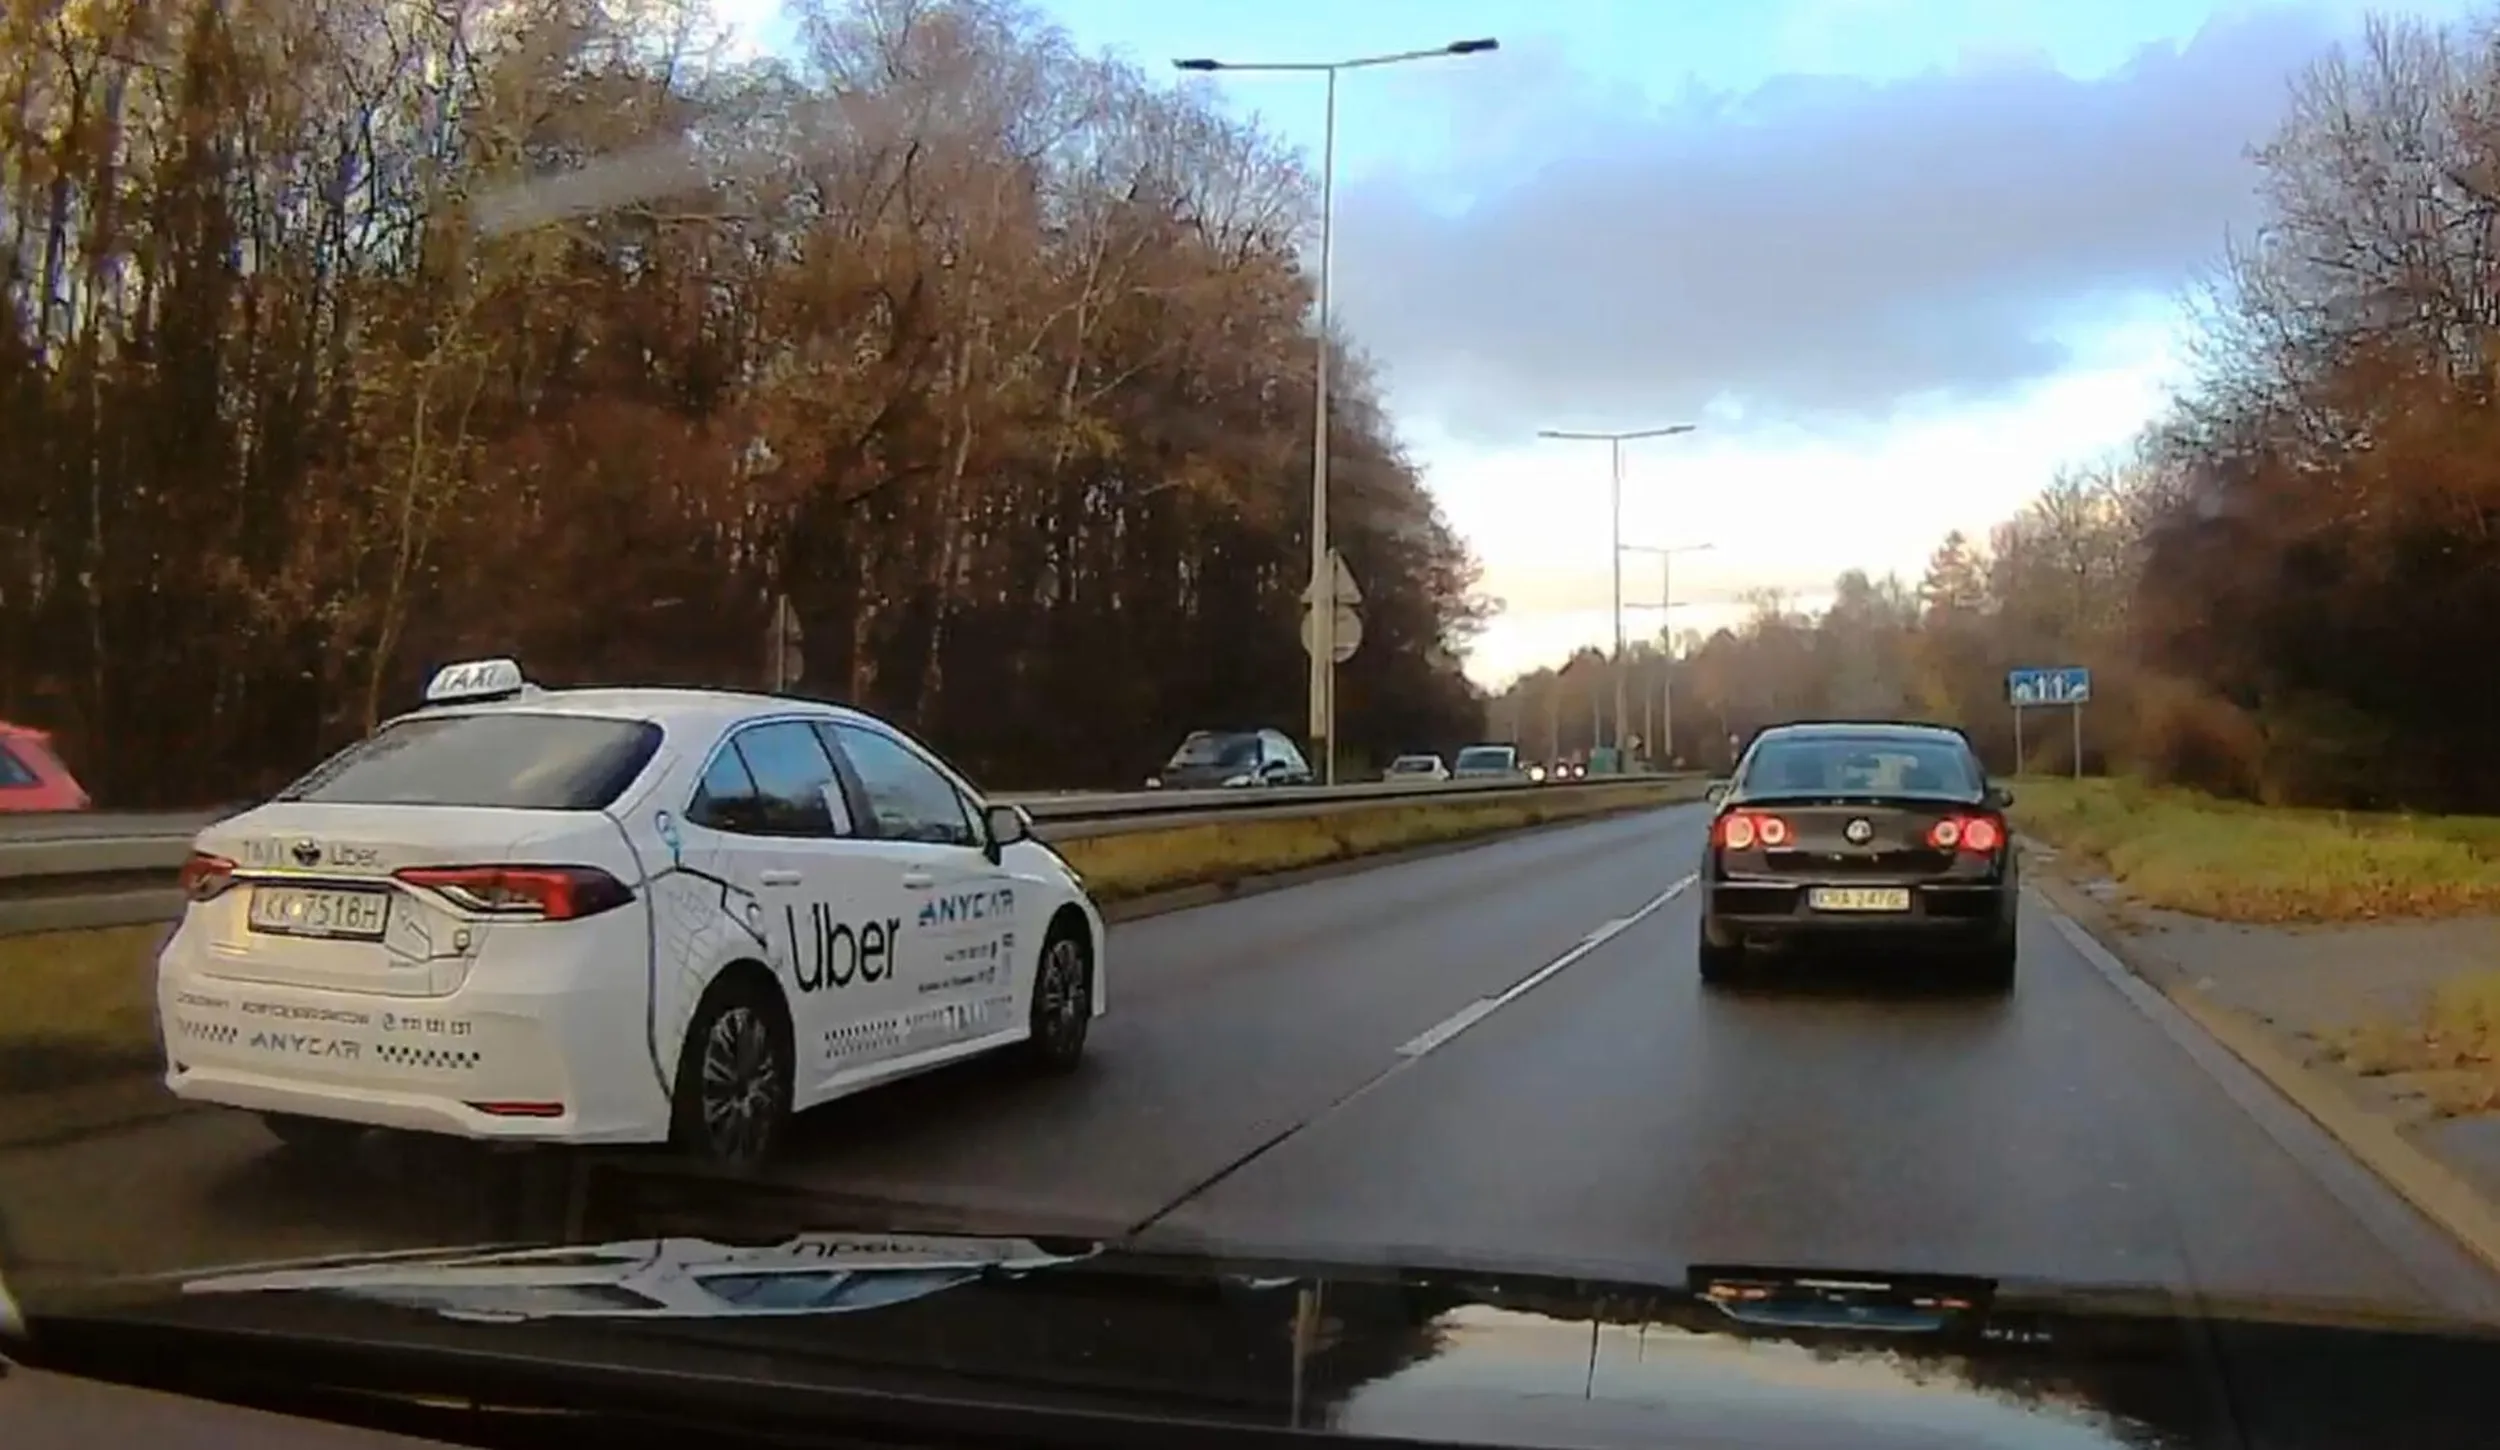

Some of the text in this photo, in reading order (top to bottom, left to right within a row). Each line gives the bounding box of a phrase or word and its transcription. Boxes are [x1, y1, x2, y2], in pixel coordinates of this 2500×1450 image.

[440, 666, 497, 691] TAXI
[918, 888, 1014, 927] ANYCAR
[785, 901, 901, 993] Uber
[250, 1030, 362, 1061] ANYCAR
